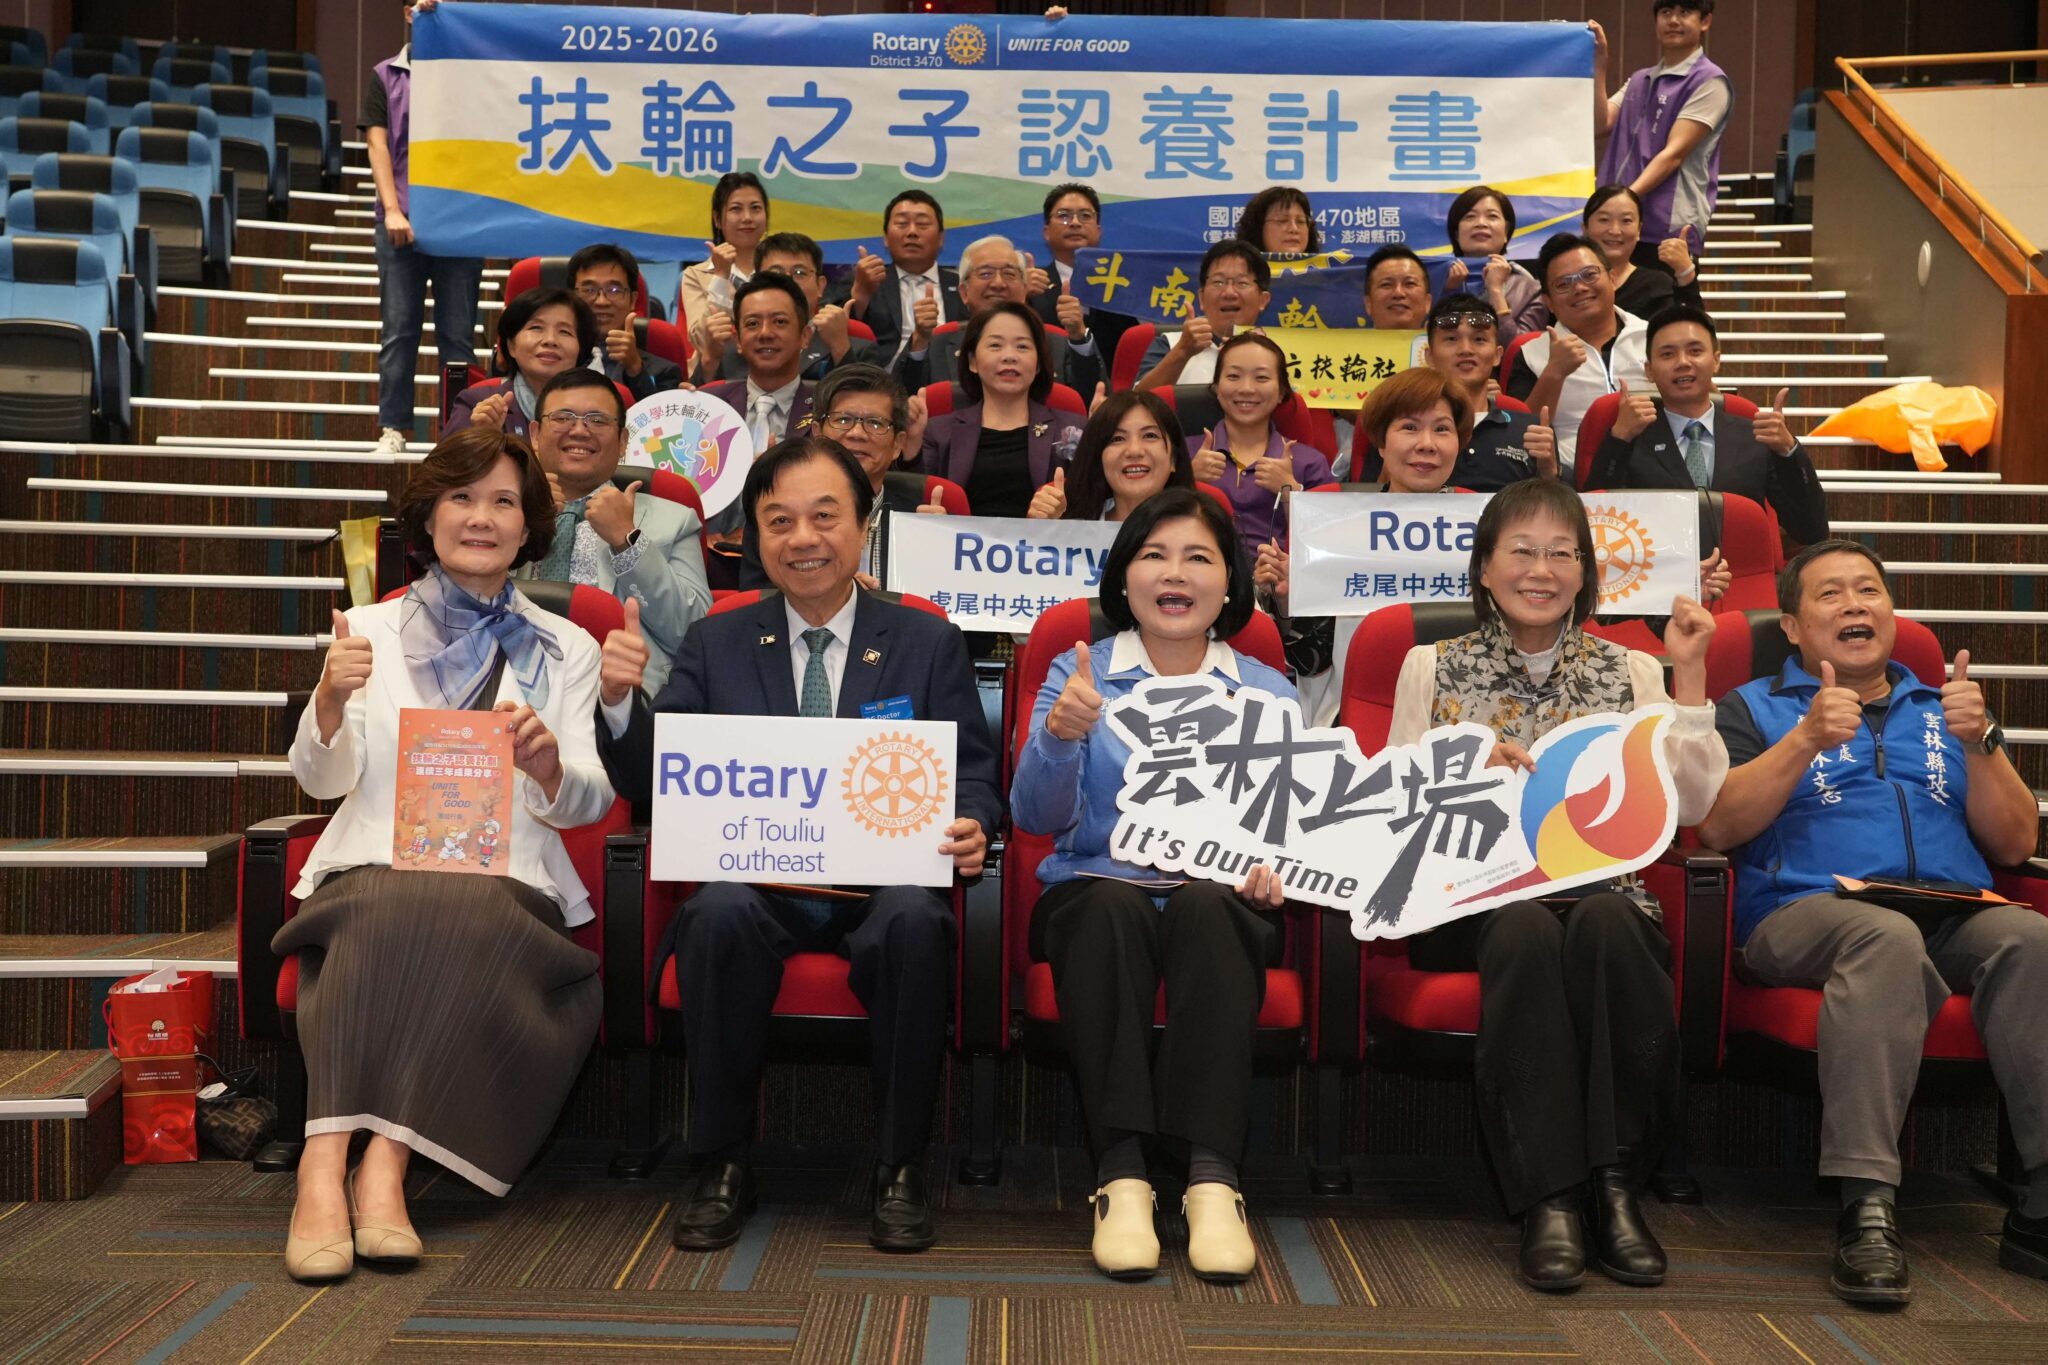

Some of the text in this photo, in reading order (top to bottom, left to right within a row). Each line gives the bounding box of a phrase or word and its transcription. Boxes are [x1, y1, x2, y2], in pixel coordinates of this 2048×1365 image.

[561, 25, 718, 53] 2025-2026
[872, 32, 940, 55] Rotary
[1007, 38, 1130, 53] UNITE FOR GOOD
[870, 55, 943, 67] District 3470
[518, 76, 1483, 182] 扶輪之子認養計畫
[1284, 353, 1396, 382] 六扶輪社
[1370, 510, 1474, 552] Rota
[954, 532, 1108, 586] Rotary
[874, 743, 918, 756] ROTARY
[432, 783, 460, 791] UNITE
[659, 752, 828, 809] Rotary
[441, 791, 460, 799] FOR
[444, 800, 471, 808] GOOD
[856, 799, 933, 828] INTERNATIONAL
[1113, 687, 1511, 931] 雲林上場
[722, 816, 825, 843] of Touliu
[719, 848, 825, 873] outheast
[1193, 840, 1265, 876] Our
[1273, 855, 1359, 899] Time
